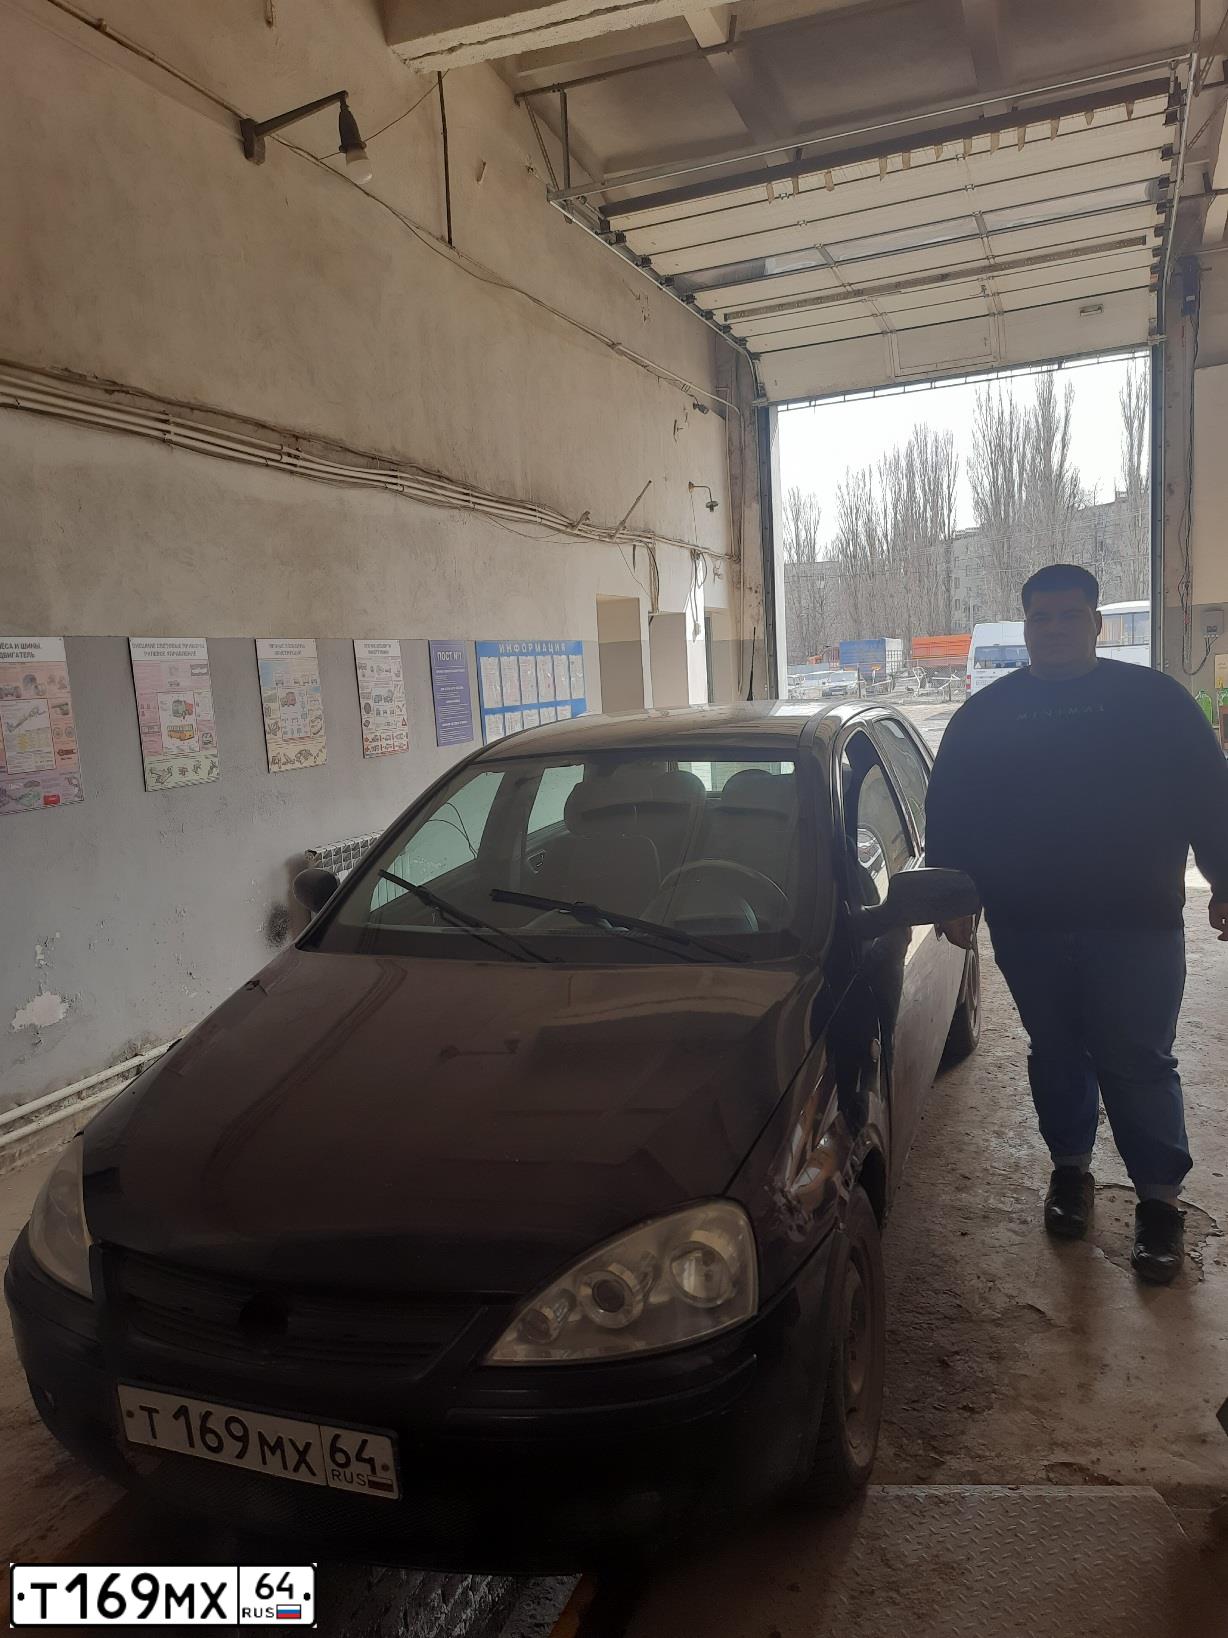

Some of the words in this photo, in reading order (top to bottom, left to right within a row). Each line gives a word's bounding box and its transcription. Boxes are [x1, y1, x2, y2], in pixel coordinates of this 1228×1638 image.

[499, 642, 566, 654] ИНФОРМАЦИЯ
[437, 651, 452, 661] ПОСТ
[329, 1433, 377, 1476] 64
[331, 1468, 368, 1487] RUS
